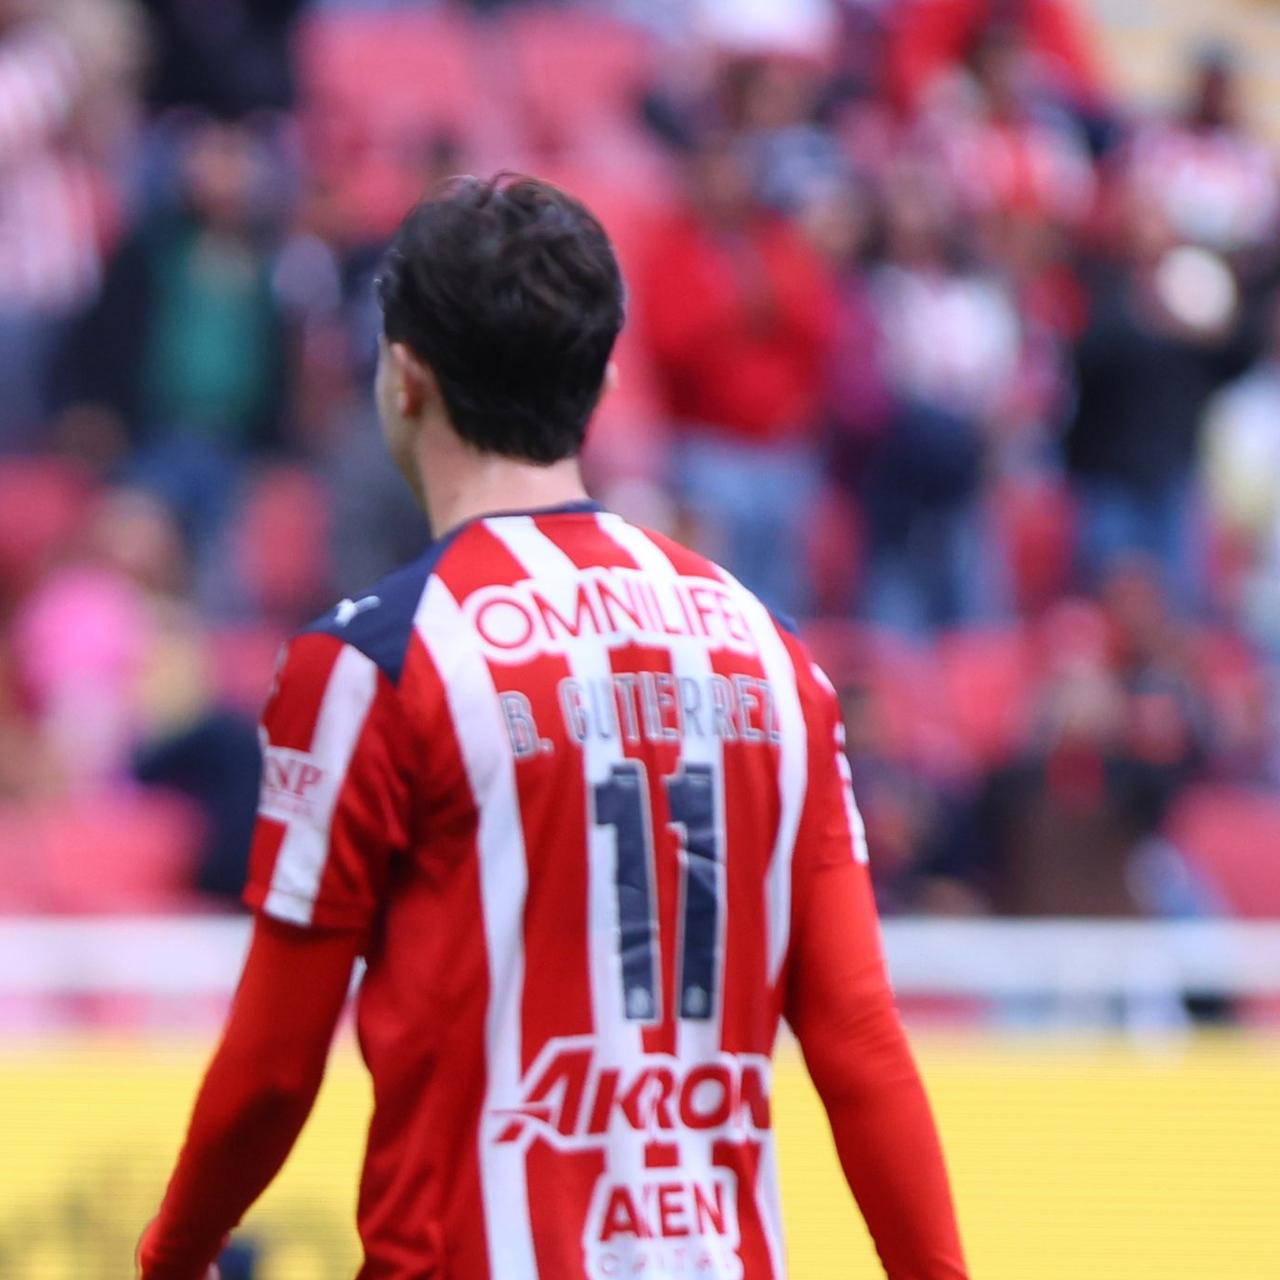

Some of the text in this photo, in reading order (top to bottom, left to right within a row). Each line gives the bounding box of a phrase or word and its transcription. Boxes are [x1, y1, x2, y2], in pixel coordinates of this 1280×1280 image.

[500, 690, 553, 760] B.
[590, 758, 723, 1021] 11
[599, 1182, 727, 1242] AEN
